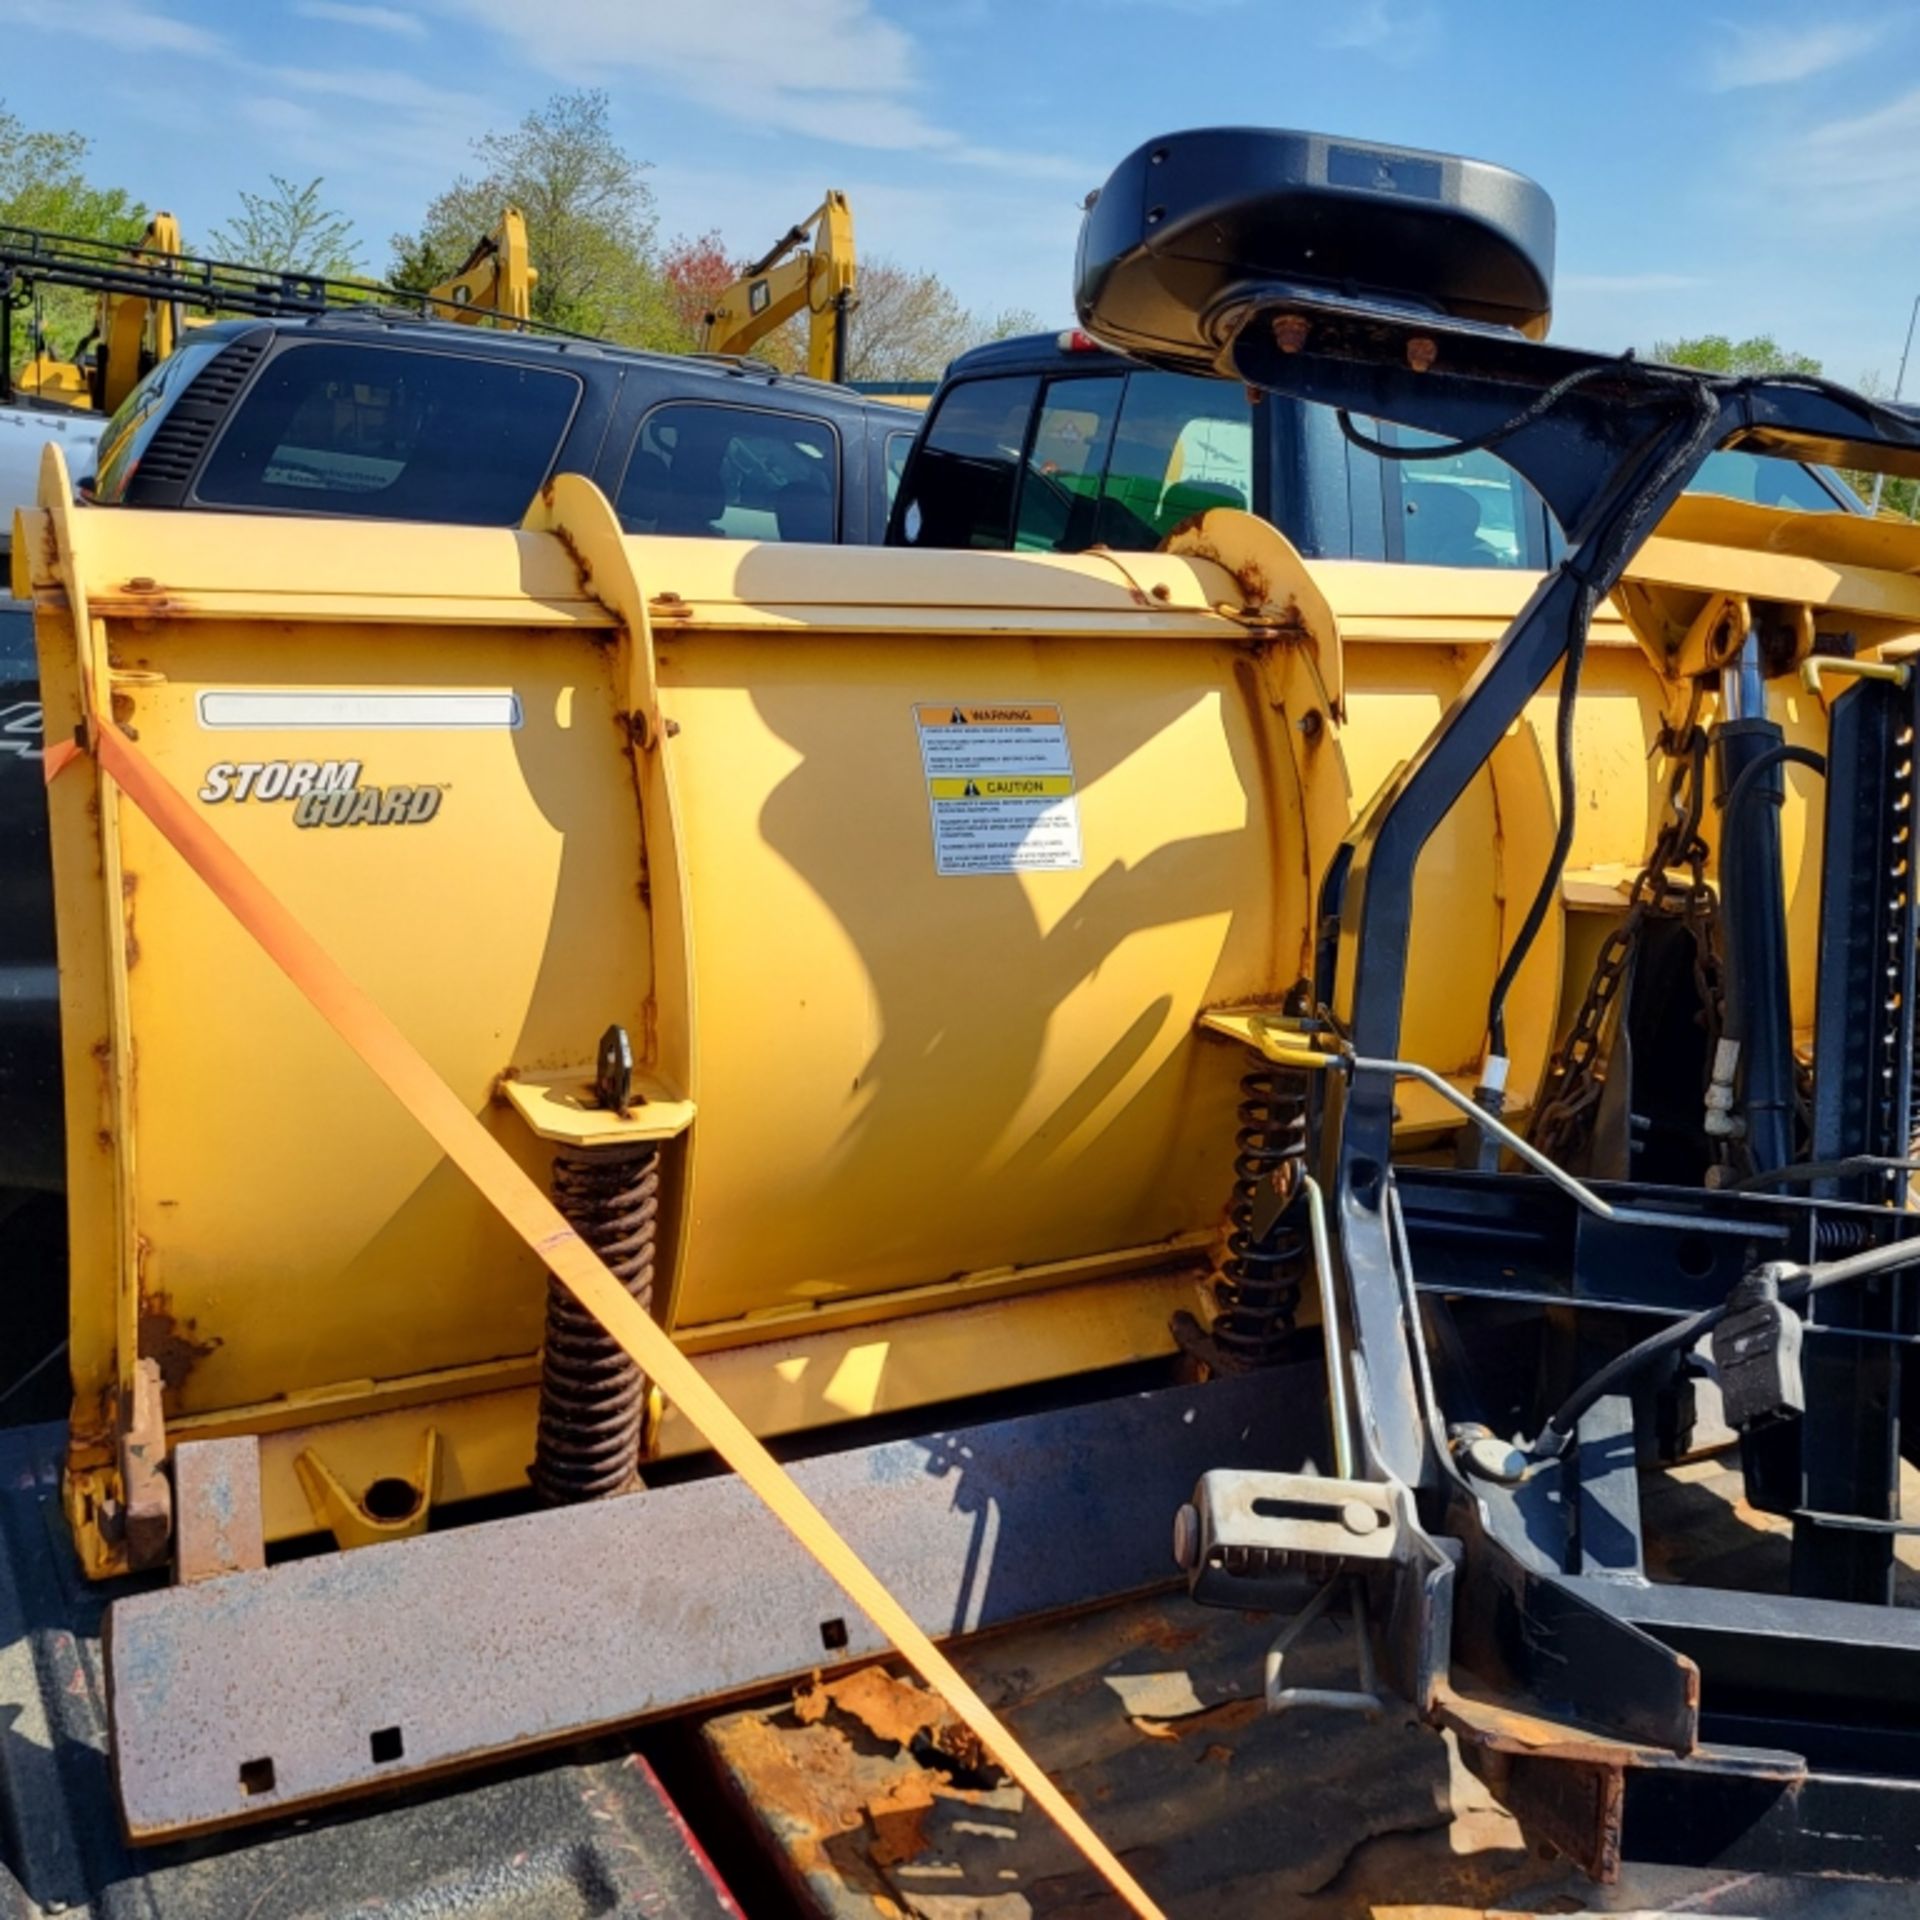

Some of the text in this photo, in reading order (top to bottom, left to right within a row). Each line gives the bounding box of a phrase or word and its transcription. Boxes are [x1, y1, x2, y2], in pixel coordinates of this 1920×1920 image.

[971, 709, 1033, 722] WARNING
[197, 760, 363, 804] STORM
[986, 780, 1044, 794] CAUTION
[292, 784, 443, 829] GUARD
